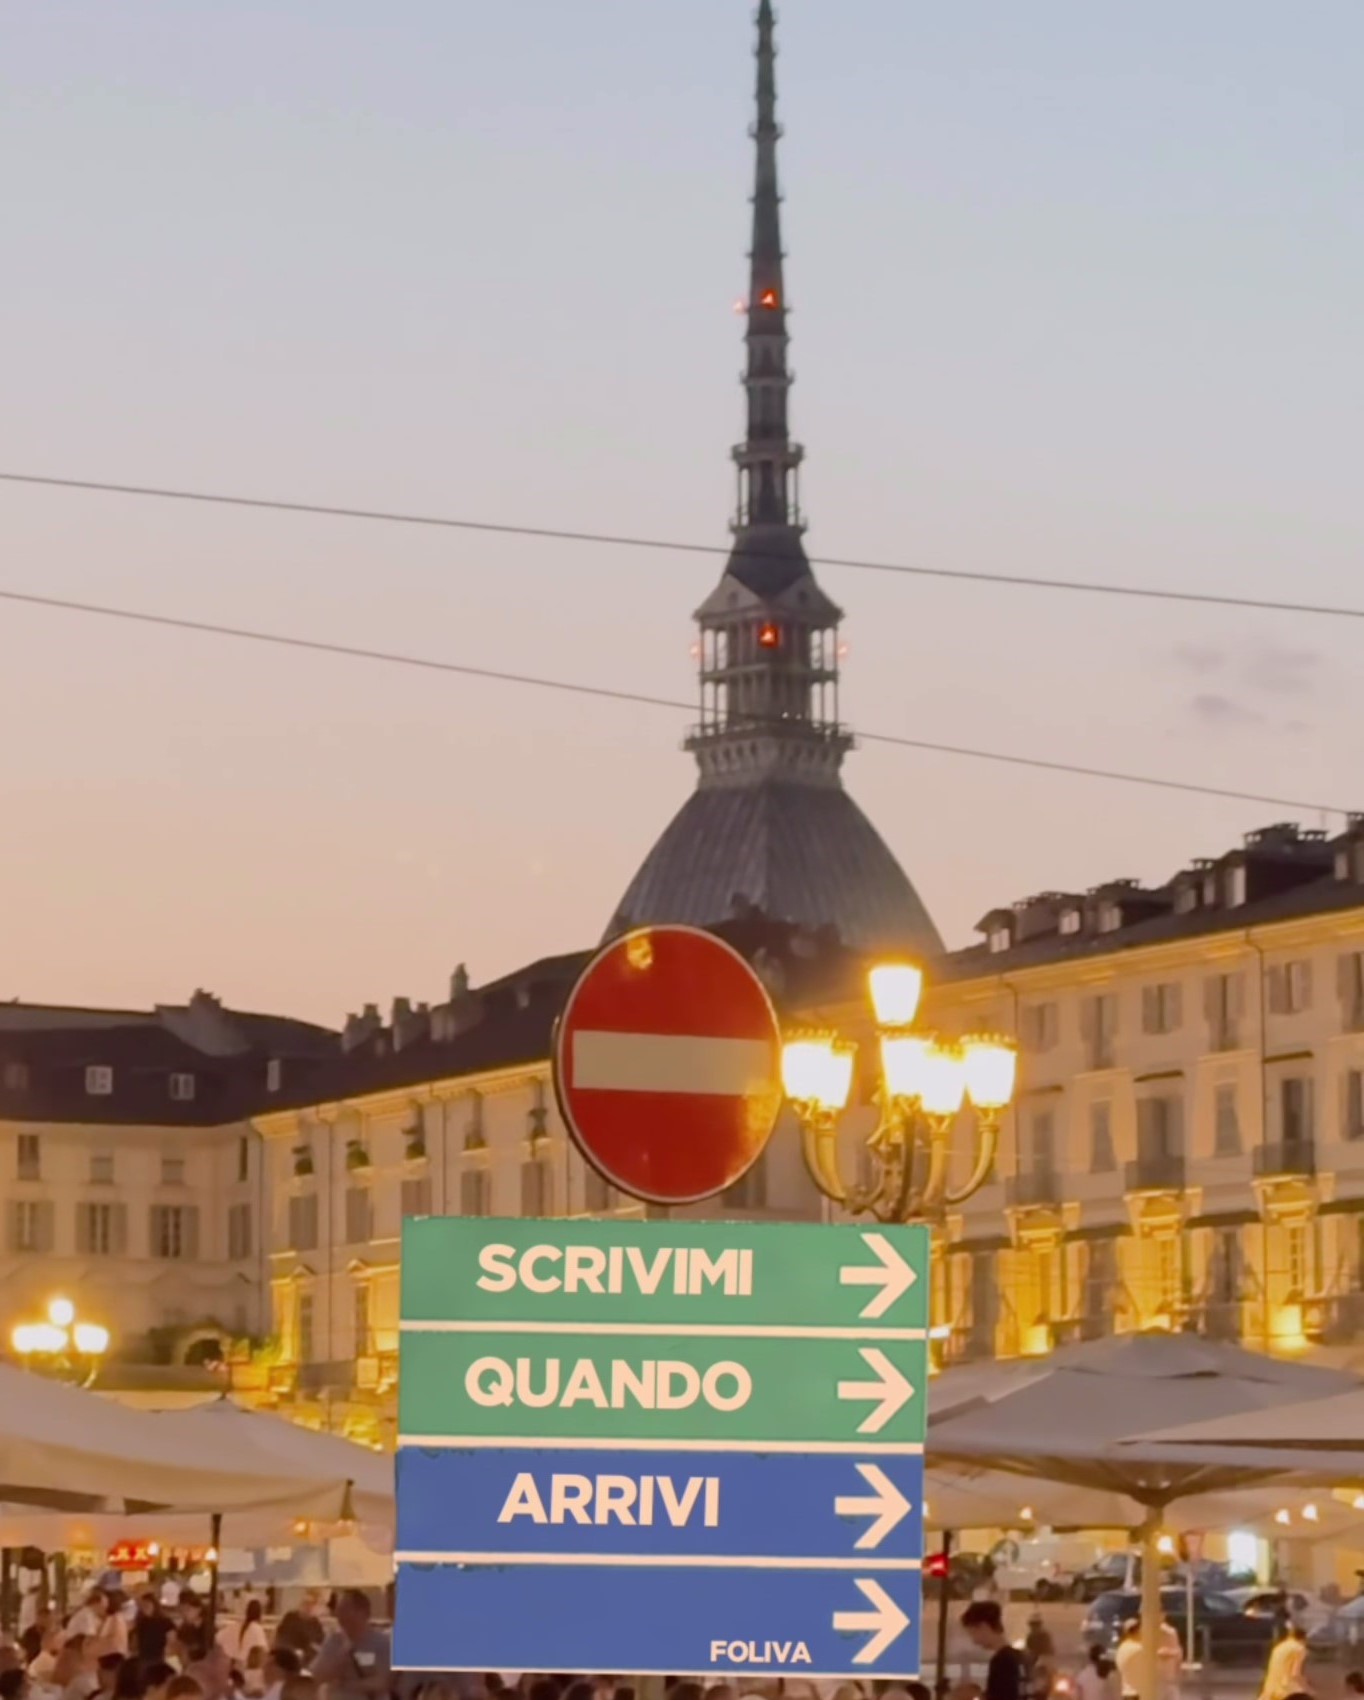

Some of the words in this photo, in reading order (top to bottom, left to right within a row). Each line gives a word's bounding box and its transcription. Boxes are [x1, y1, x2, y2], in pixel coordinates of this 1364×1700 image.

[476, 1243, 753, 1296] SCRIVIMI
[464, 1356, 752, 1412] QUANDO
[497, 1472, 720, 1527] ARRIVI
[709, 1640, 812, 1664] FOLIVA
